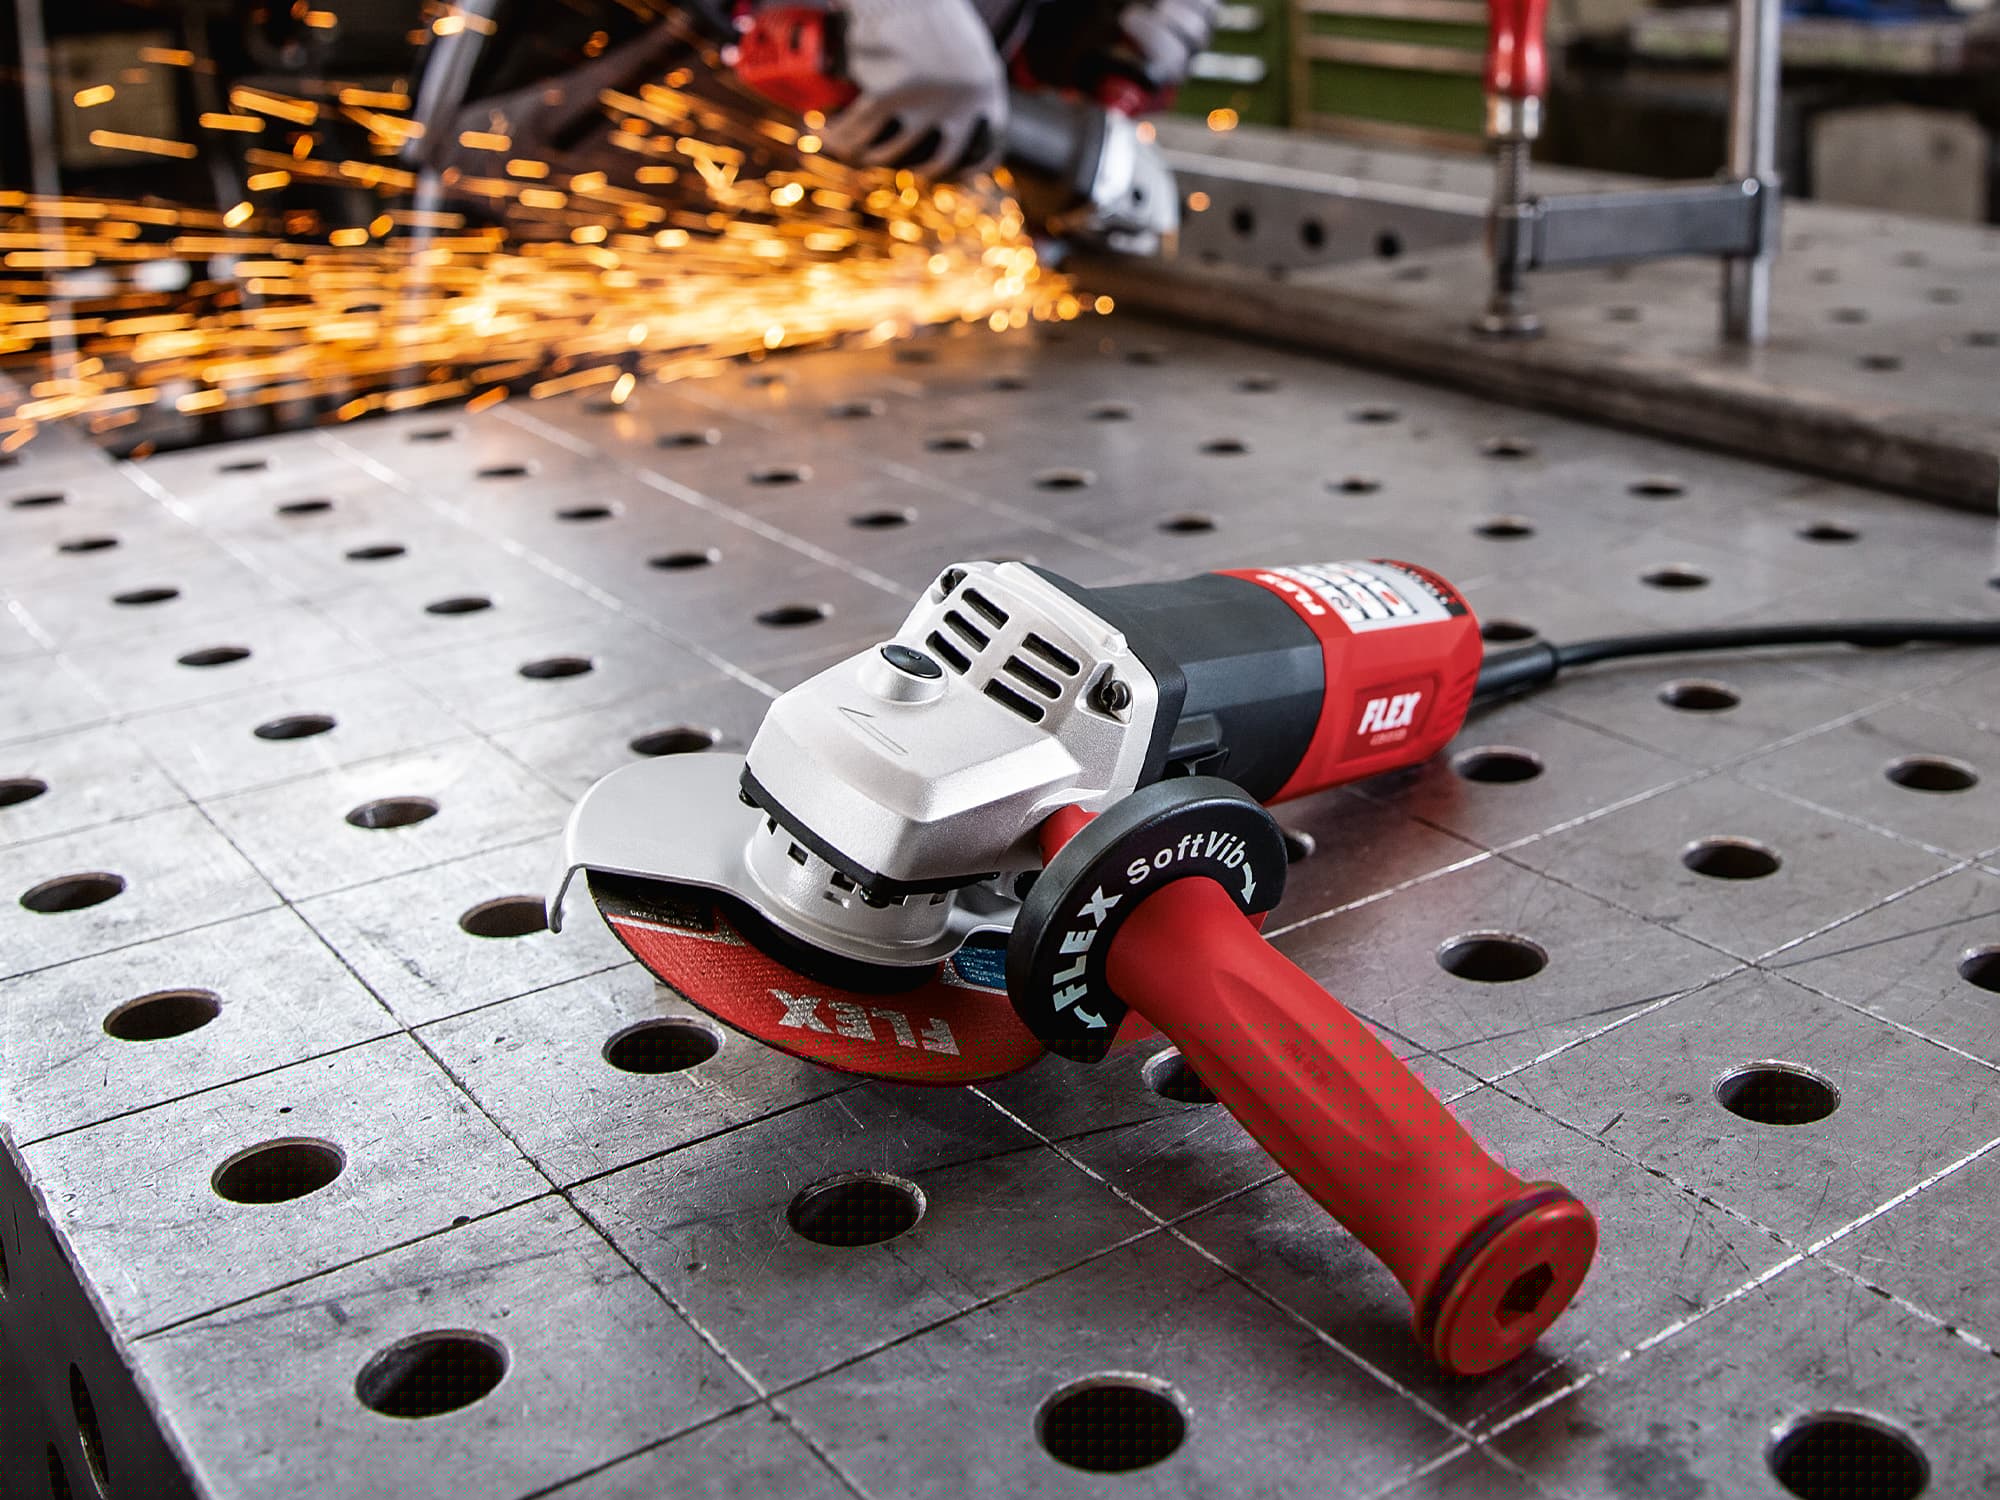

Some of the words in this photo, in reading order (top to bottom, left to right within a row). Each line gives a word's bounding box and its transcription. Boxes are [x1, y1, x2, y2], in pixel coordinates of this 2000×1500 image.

[1357, 691, 1422, 735] FLEX
[1053, 885, 1123, 1012] FLEX
[1127, 831, 1247, 885] SoftVib
[767, 988, 961, 1056] FLEX
